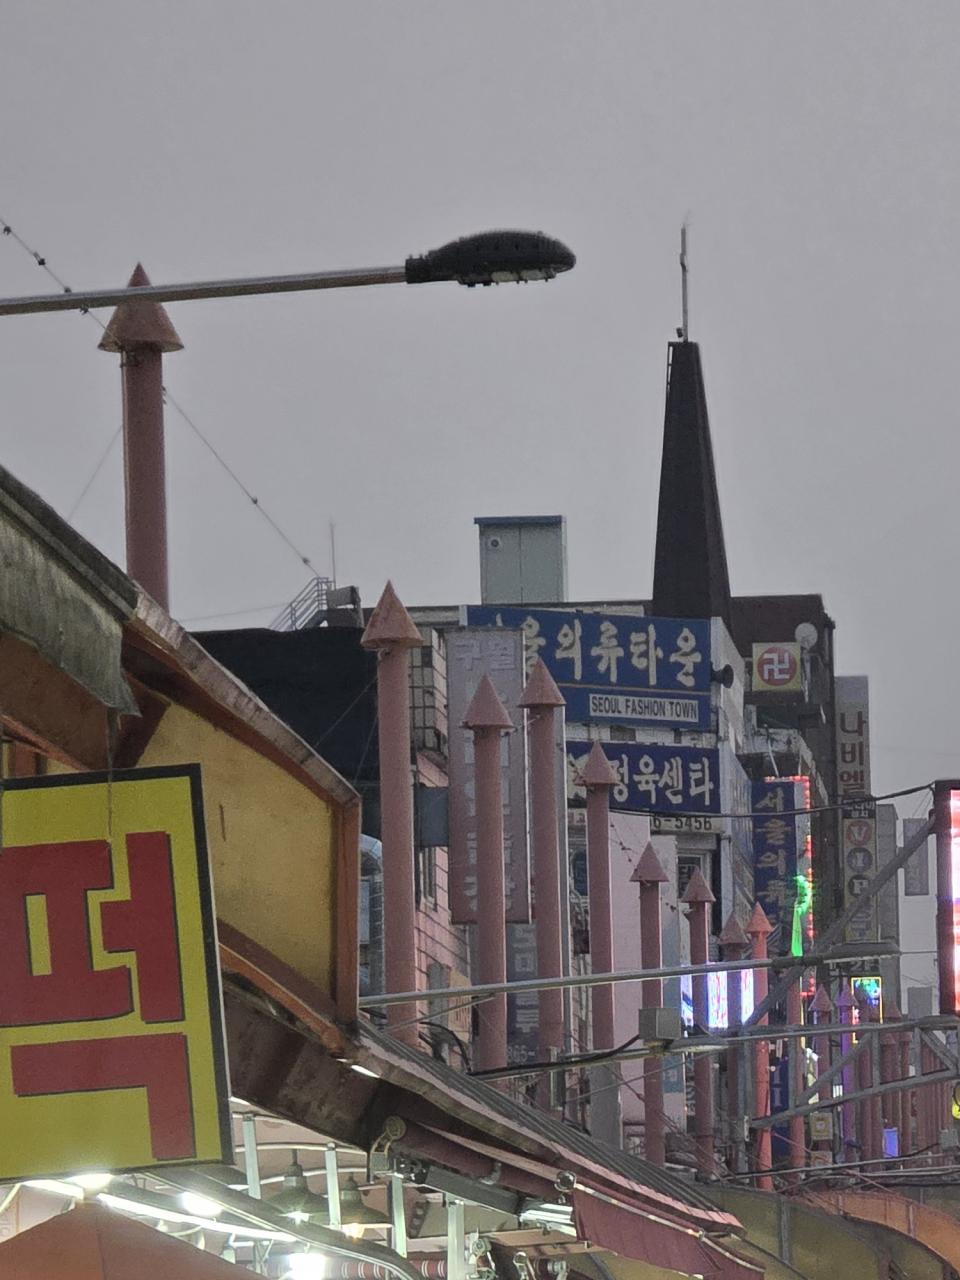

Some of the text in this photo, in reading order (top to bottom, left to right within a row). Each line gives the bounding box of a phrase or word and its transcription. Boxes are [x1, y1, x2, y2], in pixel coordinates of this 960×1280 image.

[496, 613, 701, 687] 울의류타운
[591, 696, 698, 719] SEOUL FASHION TOWN
[650, 815, 713, 830] 6-5456
[754, 787, 792, 916] 서울의류
